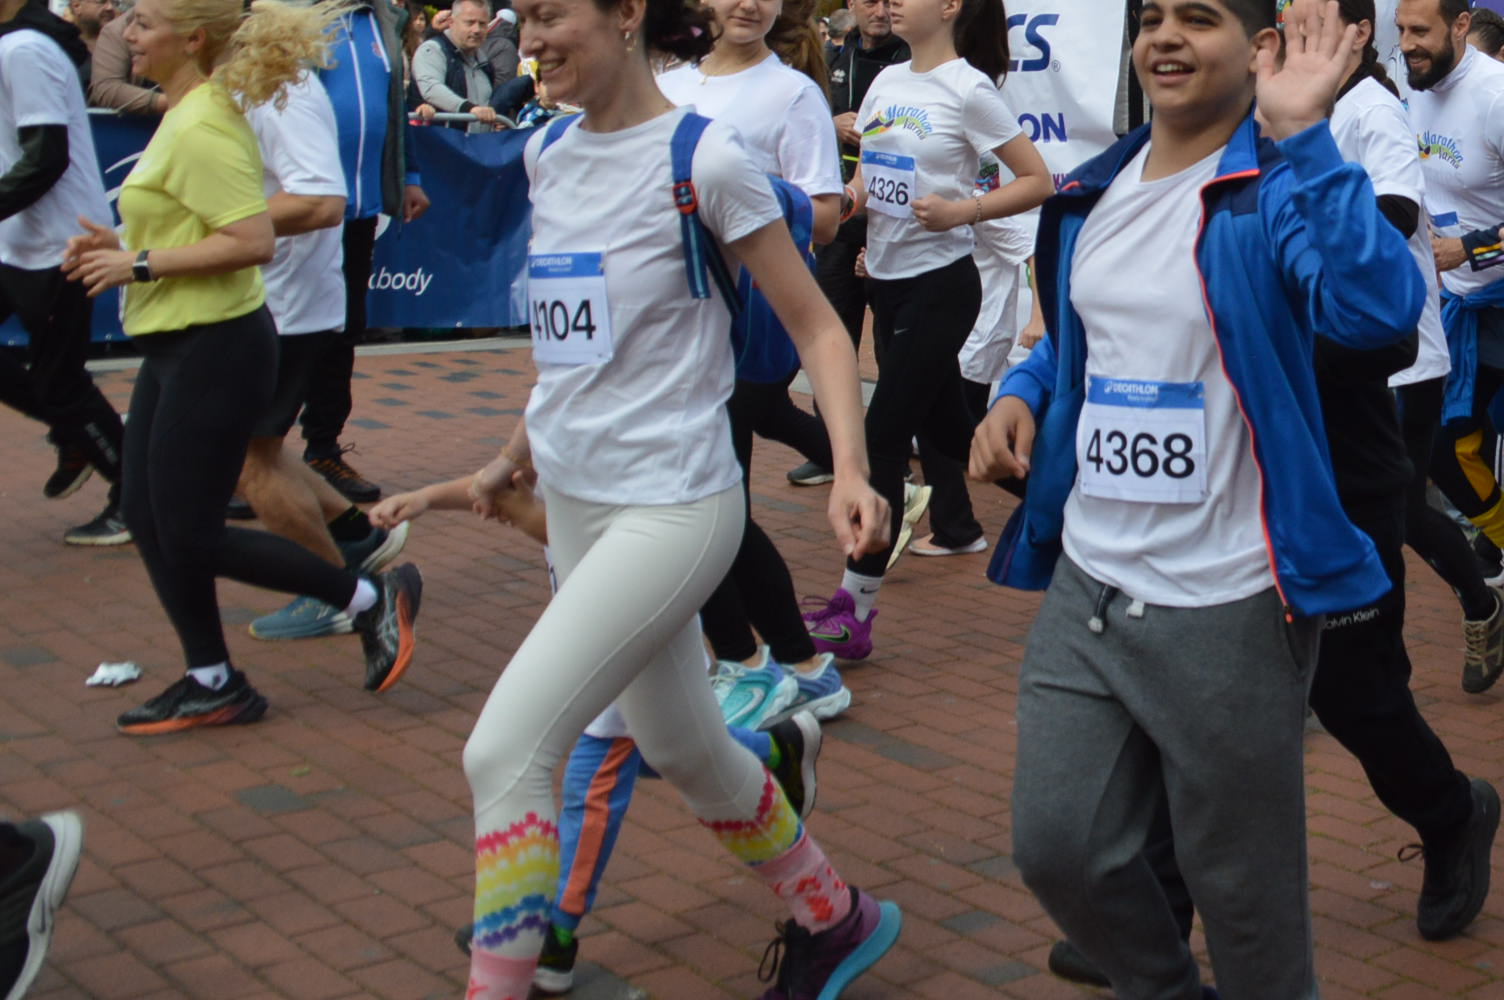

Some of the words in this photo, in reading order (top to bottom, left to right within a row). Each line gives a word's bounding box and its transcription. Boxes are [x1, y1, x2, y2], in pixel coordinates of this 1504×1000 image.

[868, 176, 909, 206] 4326
[1086, 428, 1196, 479] 4368
[1353, 607, 1380, 623] Klein
